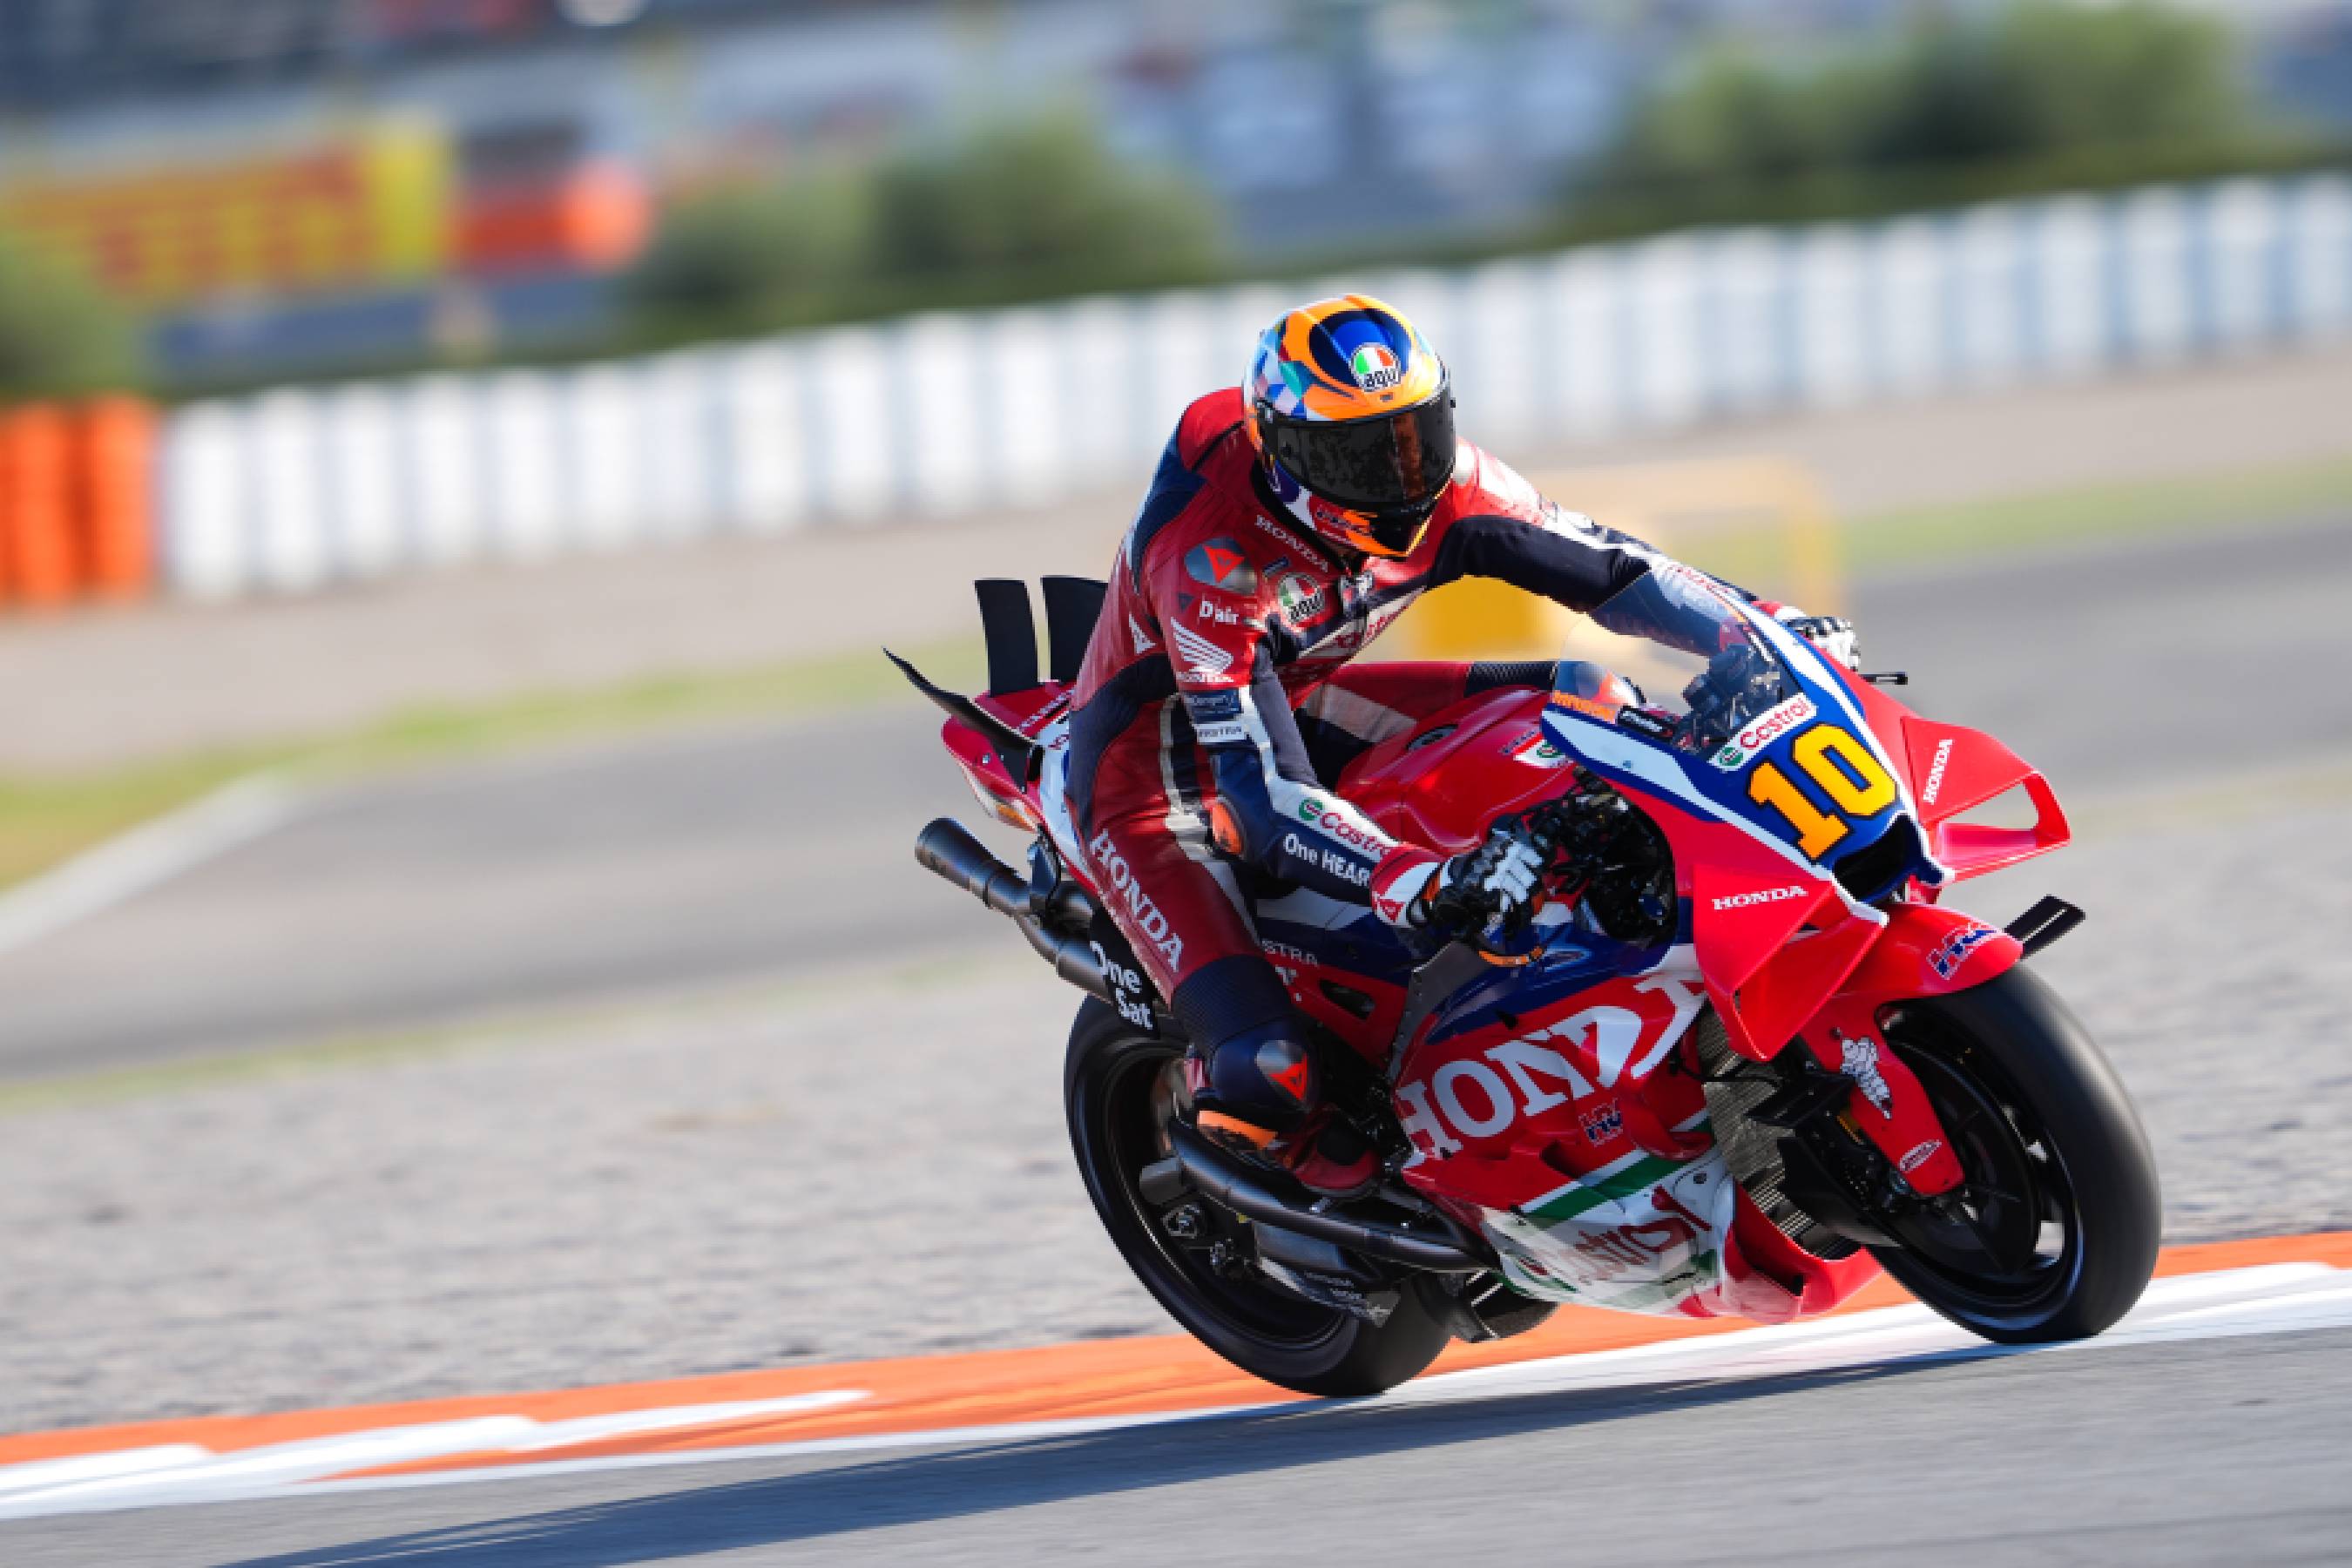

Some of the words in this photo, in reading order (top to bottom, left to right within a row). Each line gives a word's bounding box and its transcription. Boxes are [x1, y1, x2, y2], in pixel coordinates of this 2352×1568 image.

[1740, 697, 1812, 749] Castrol
[1748, 723, 1898, 865] 10
[1923, 739, 1954, 805] HONDA
[1282, 832, 1318, 867] One
[1321, 849, 1370, 888] HEAR
[1319, 811, 1396, 859] Castr
[1090, 828, 1184, 973] HONDA
[1711, 885, 1808, 910] HONDA
[1261, 938, 1319, 969] STRA
